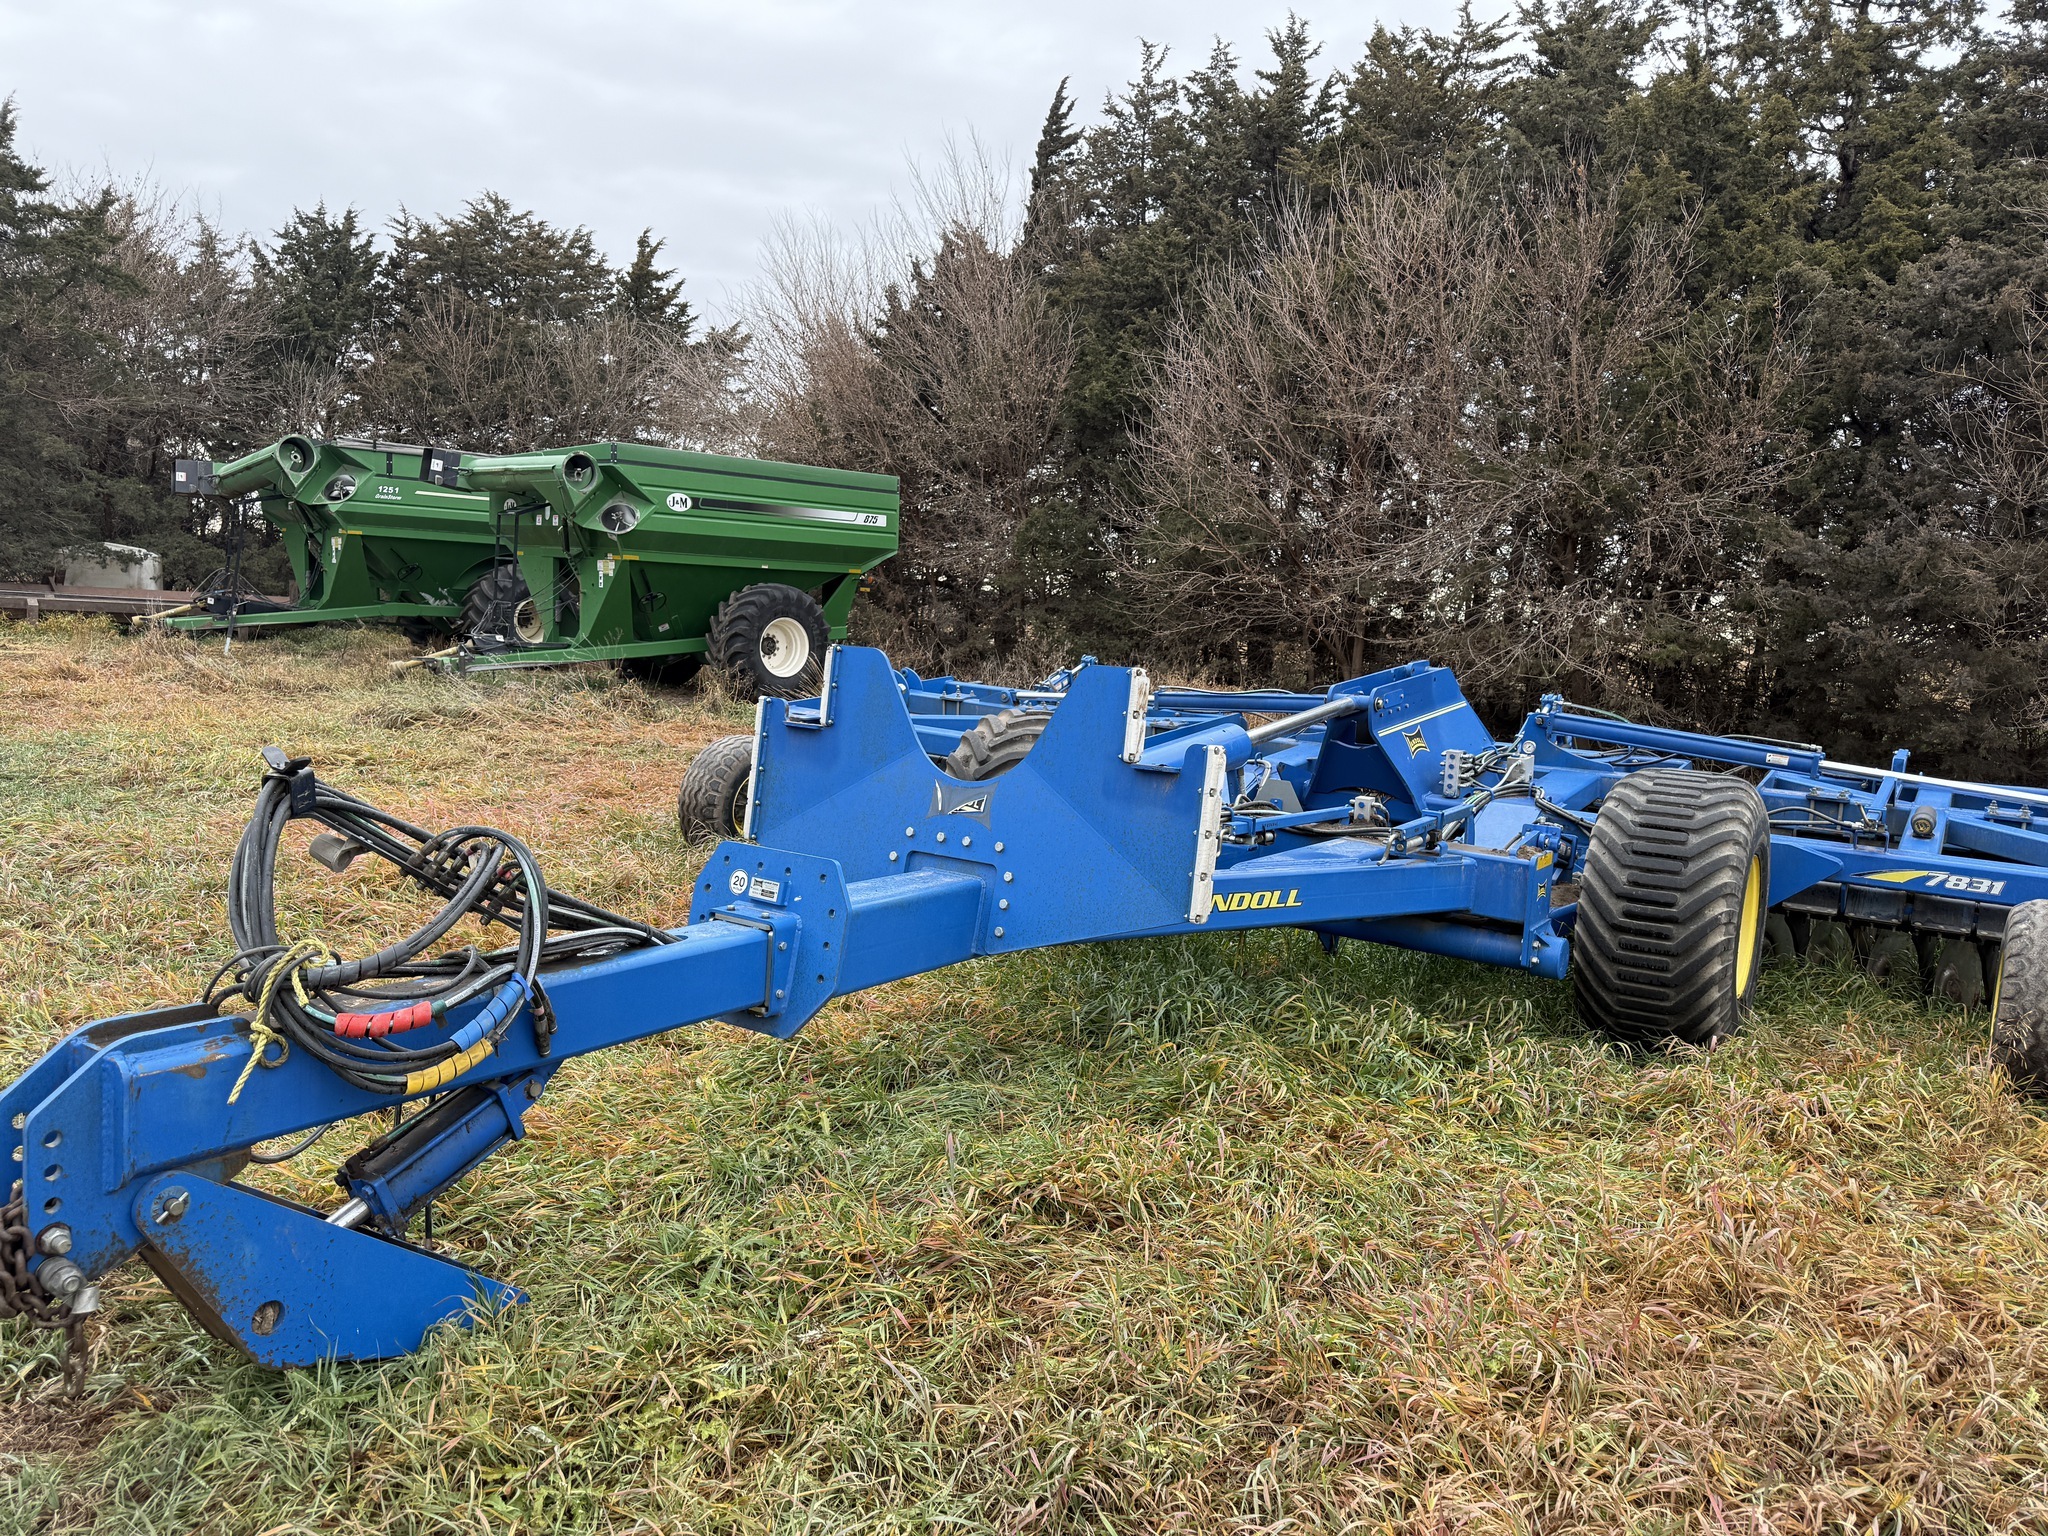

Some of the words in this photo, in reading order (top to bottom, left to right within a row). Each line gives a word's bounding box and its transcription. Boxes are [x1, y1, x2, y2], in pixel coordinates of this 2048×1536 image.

[378, 485, 400, 494] 1251
[669, 496, 688, 508] J&M
[863, 515, 879, 524] 875
[733, 875, 746, 888] 20
[1924, 871, 2007, 896] 7831
